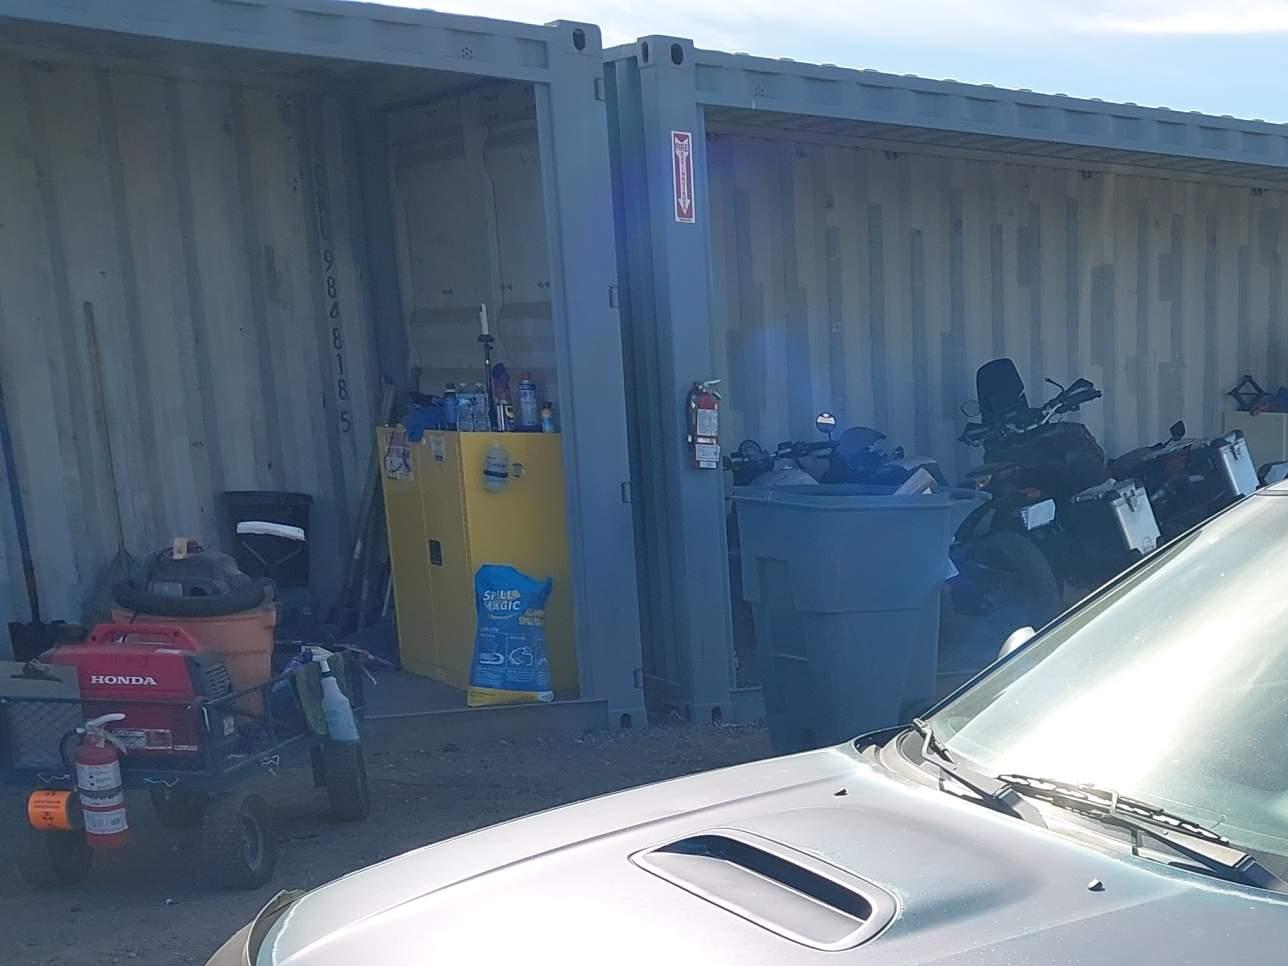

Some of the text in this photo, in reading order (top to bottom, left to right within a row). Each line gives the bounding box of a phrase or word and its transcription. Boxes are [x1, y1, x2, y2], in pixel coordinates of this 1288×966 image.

[340, 411, 351, 432] 5
[484, 600, 521, 611] MAGIC
[91, 675, 157, 686] HONDA
